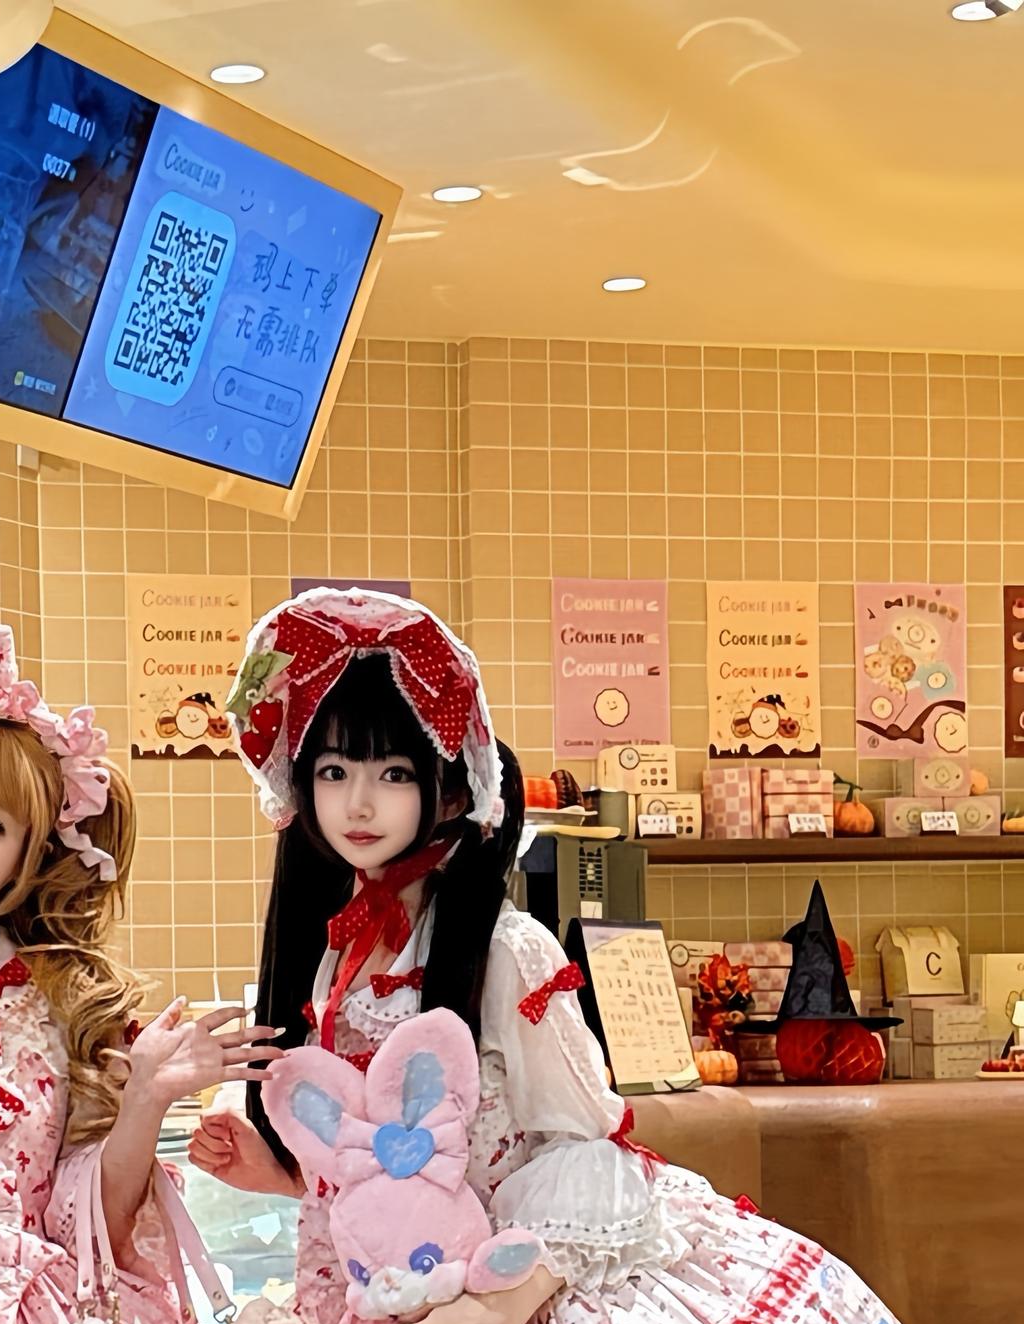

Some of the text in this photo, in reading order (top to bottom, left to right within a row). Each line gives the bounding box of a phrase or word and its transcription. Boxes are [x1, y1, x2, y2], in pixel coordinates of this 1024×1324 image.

[235, 304, 320, 363] 无需排队
[142, 589, 222, 608] COOKIE JAR
[142, 623, 223, 643] COOKIE JAR
[560, 624, 645, 646] COOKIE JAR
[719, 629, 792, 648] COOKIE JAR
[143, 657, 223, 677] COOKIE JAR
[562, 657, 645, 678] COOKIE JAR
[926, 952, 942, 976] C
